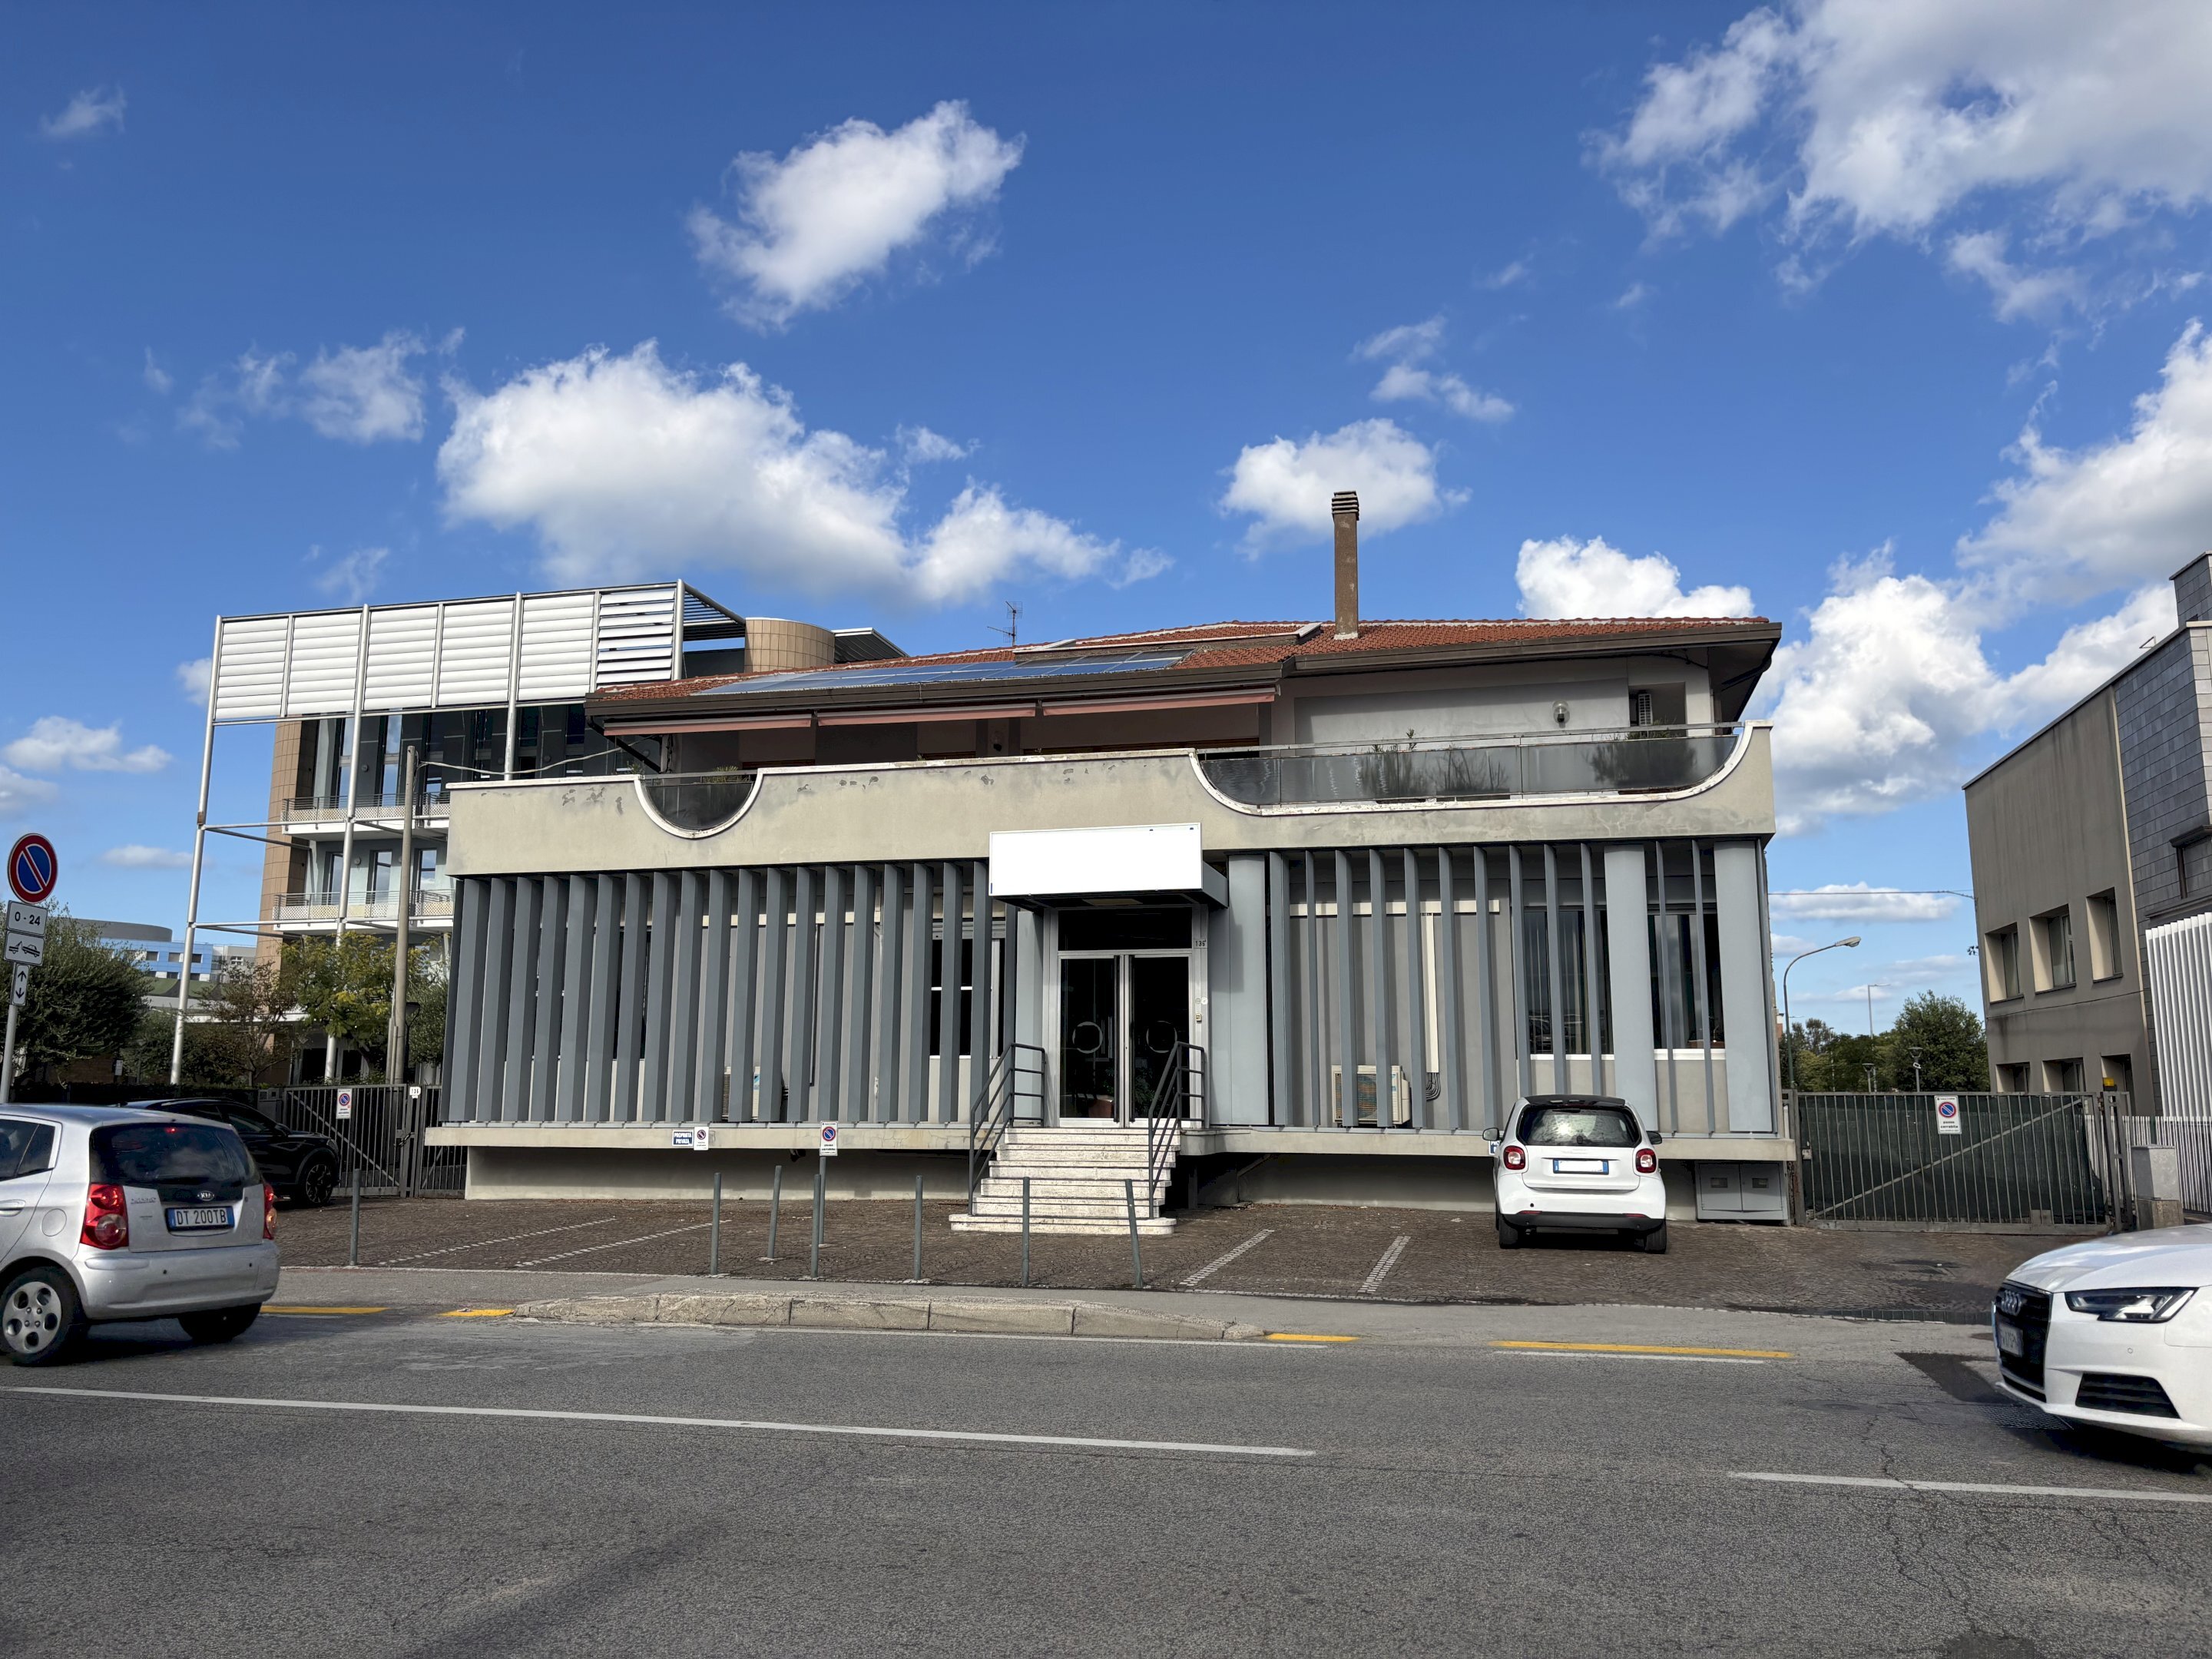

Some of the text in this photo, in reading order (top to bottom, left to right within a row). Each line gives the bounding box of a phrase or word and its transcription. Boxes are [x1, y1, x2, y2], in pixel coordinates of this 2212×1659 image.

[15, 912, 21, 922] 0
[29, 914, 41, 926] 24
[176, 1209, 227, 1225] DT 200TB
